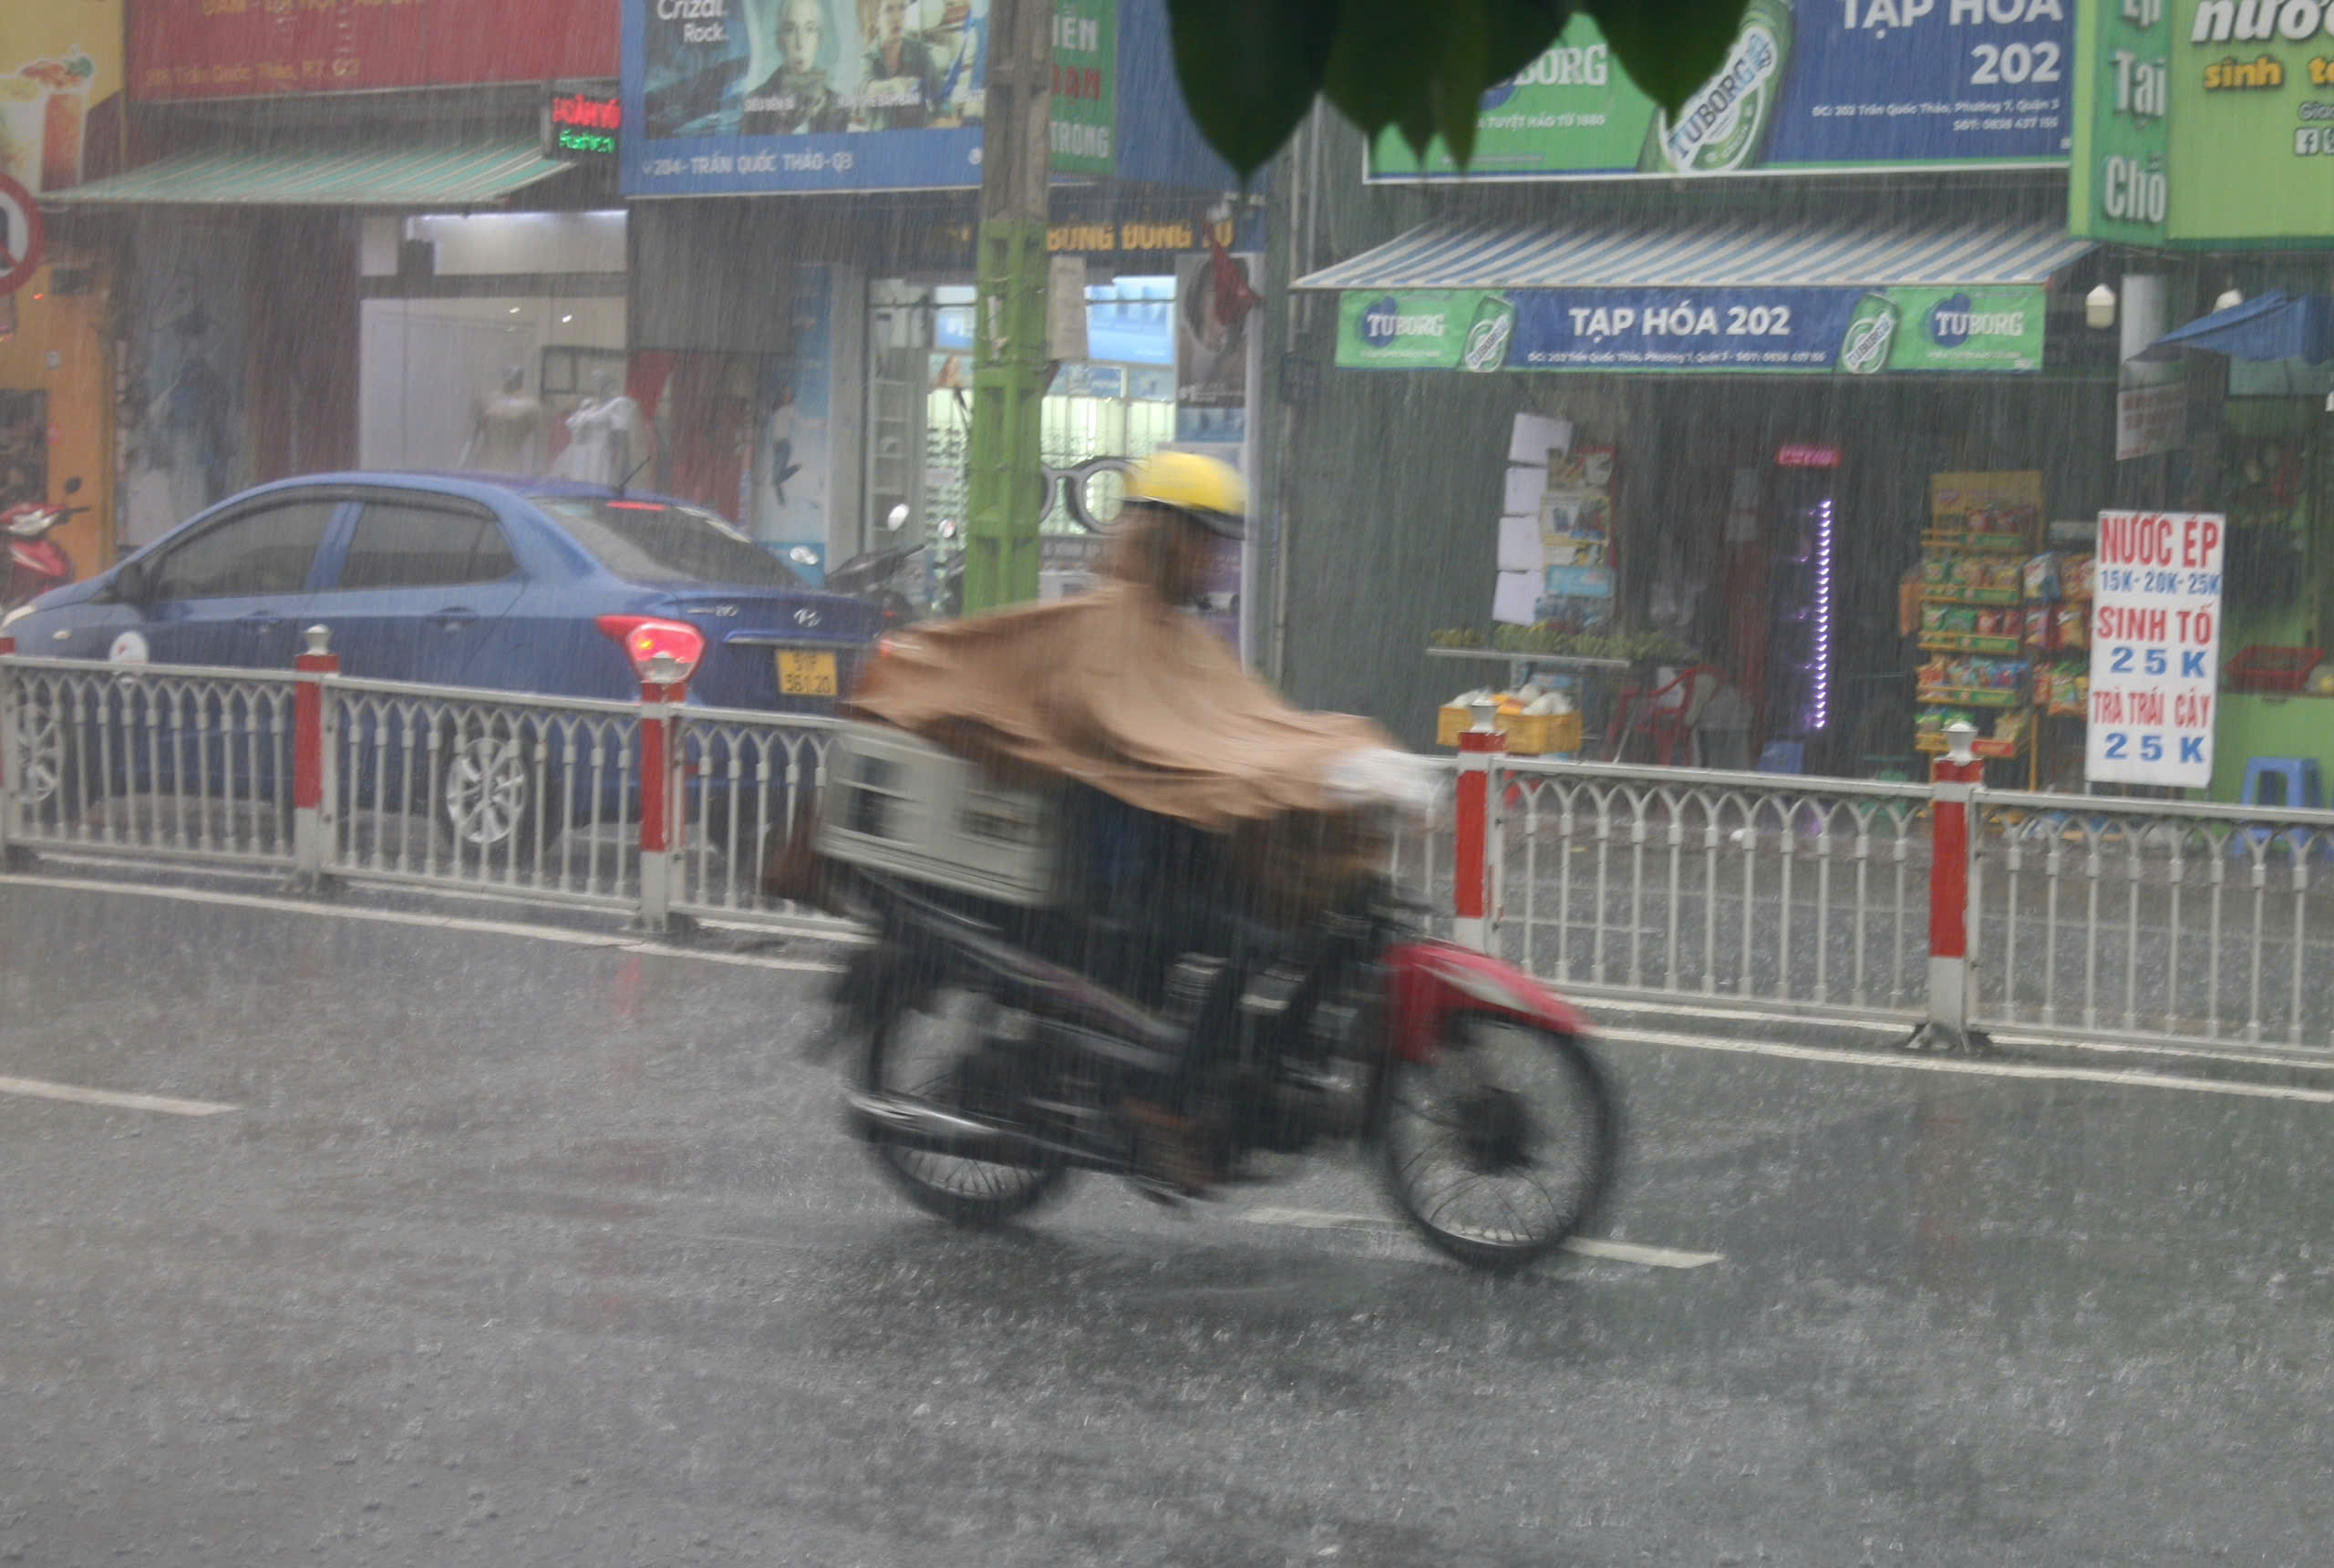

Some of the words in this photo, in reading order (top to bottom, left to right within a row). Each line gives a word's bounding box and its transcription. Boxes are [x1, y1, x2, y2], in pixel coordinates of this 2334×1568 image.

[1970, 40, 2061, 85] 202
[2204, 55, 2284, 88] sinh
[1668, 57, 1756, 160] TUBORG
[1367, 313, 1445, 337] TUBORG
[1567, 307, 1636, 344] TẠP
[1641, 300, 1720, 336] HÓA
[1725, 305, 1792, 335] 202
[1935, 311, 2024, 336] TUBORG
[2100, 513, 2174, 567] NƯỚC
[2182, 513, 2219, 568] ÉP
[2097, 605, 2167, 642] SINH
[2175, 602, 2215, 645] TỐ
[2128, 686, 2165, 727] TRÁI
